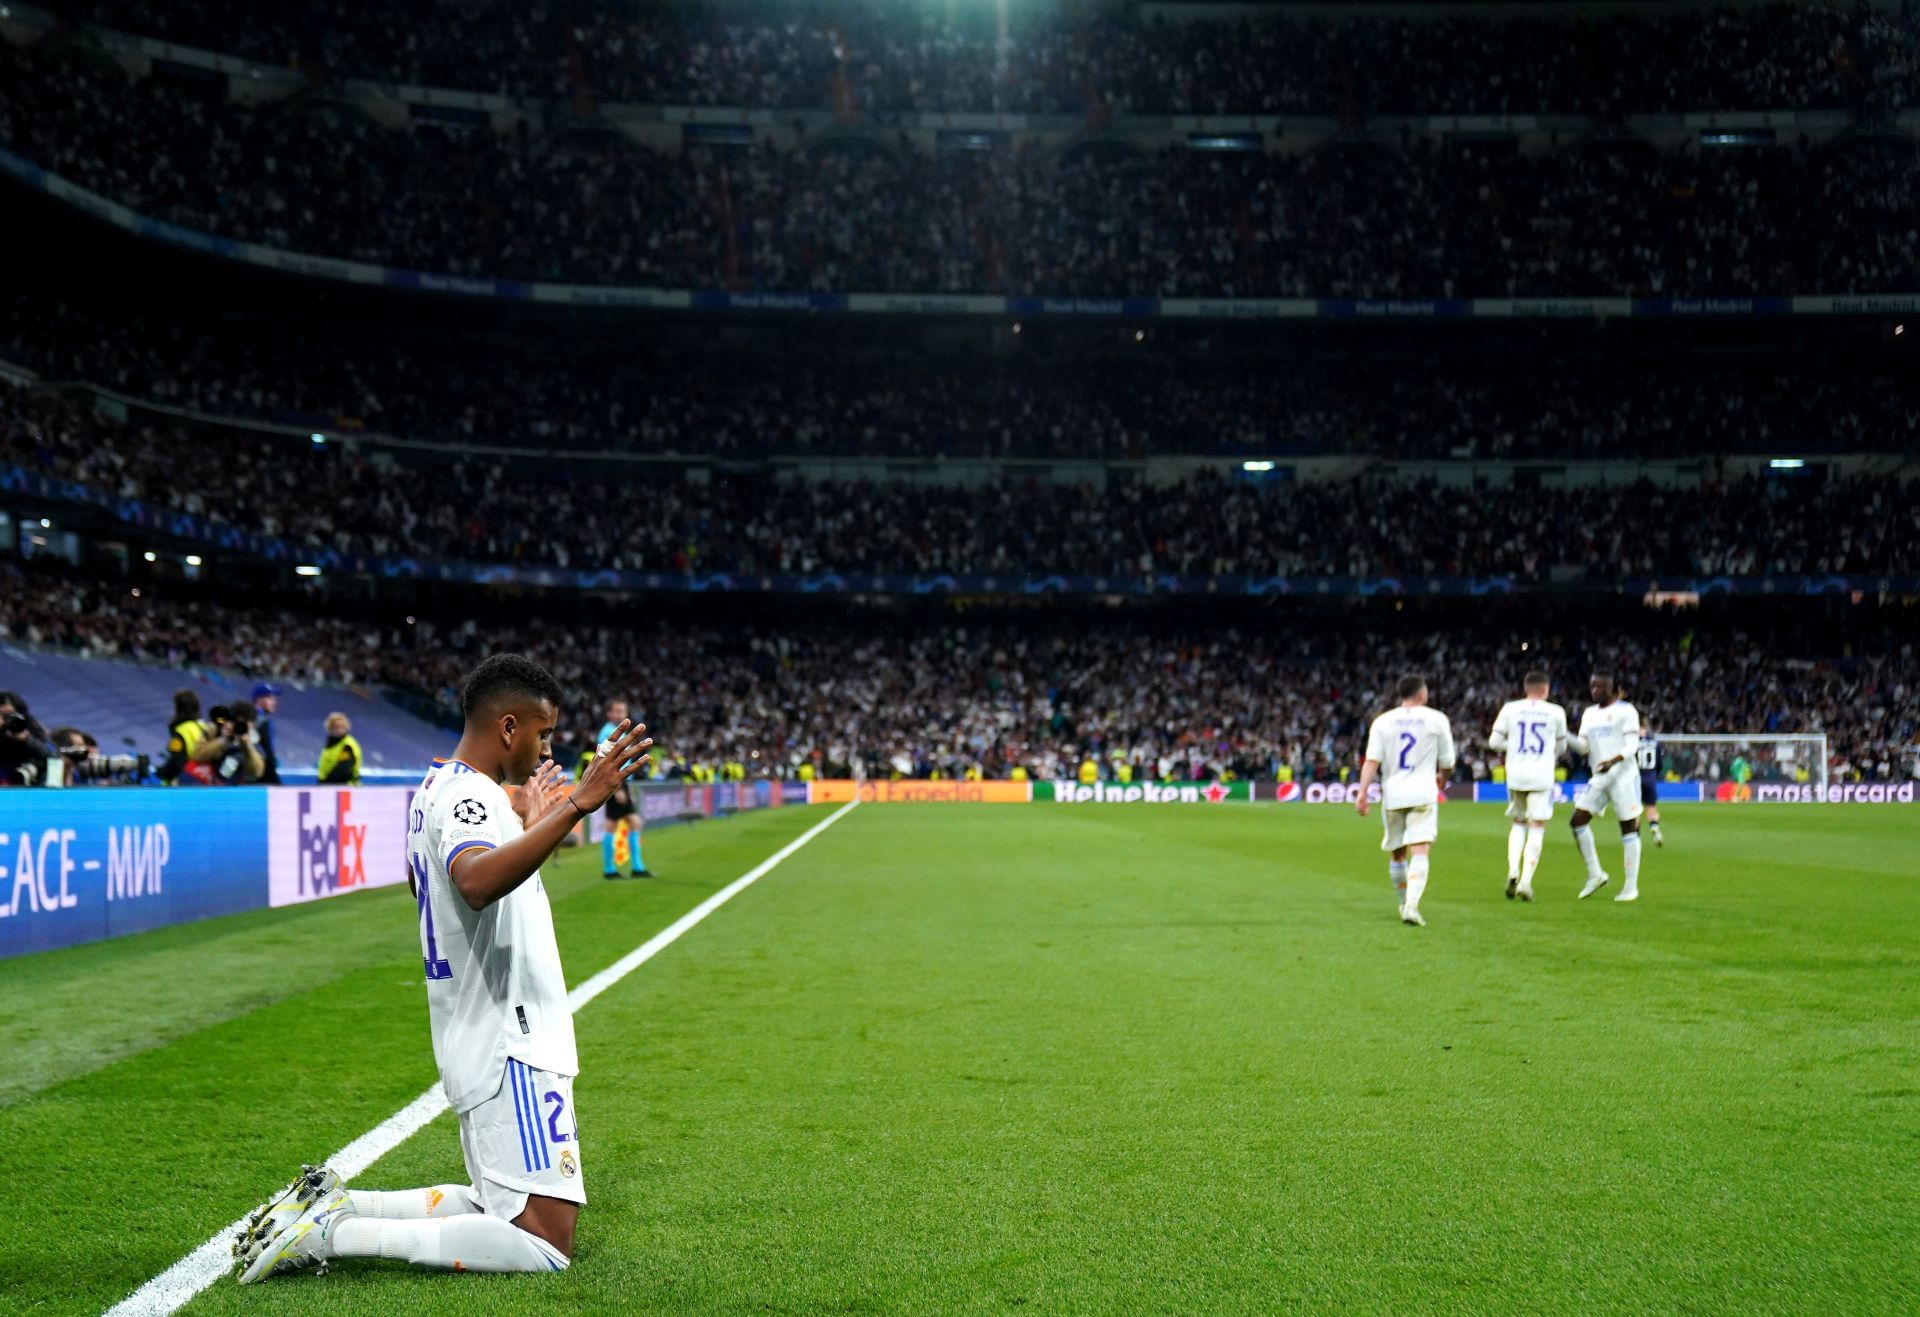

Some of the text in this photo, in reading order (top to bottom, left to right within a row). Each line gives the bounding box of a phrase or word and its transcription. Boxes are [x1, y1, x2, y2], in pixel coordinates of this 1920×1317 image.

[1398, 732, 1417, 770] 2
[1517, 720, 1548, 754] 15
[1053, 779, 1200, 802] Heineken
[1757, 780, 1915, 802] mastercard
[298, 791, 366, 896] FedEx
[107, 823, 170, 902] МИР
